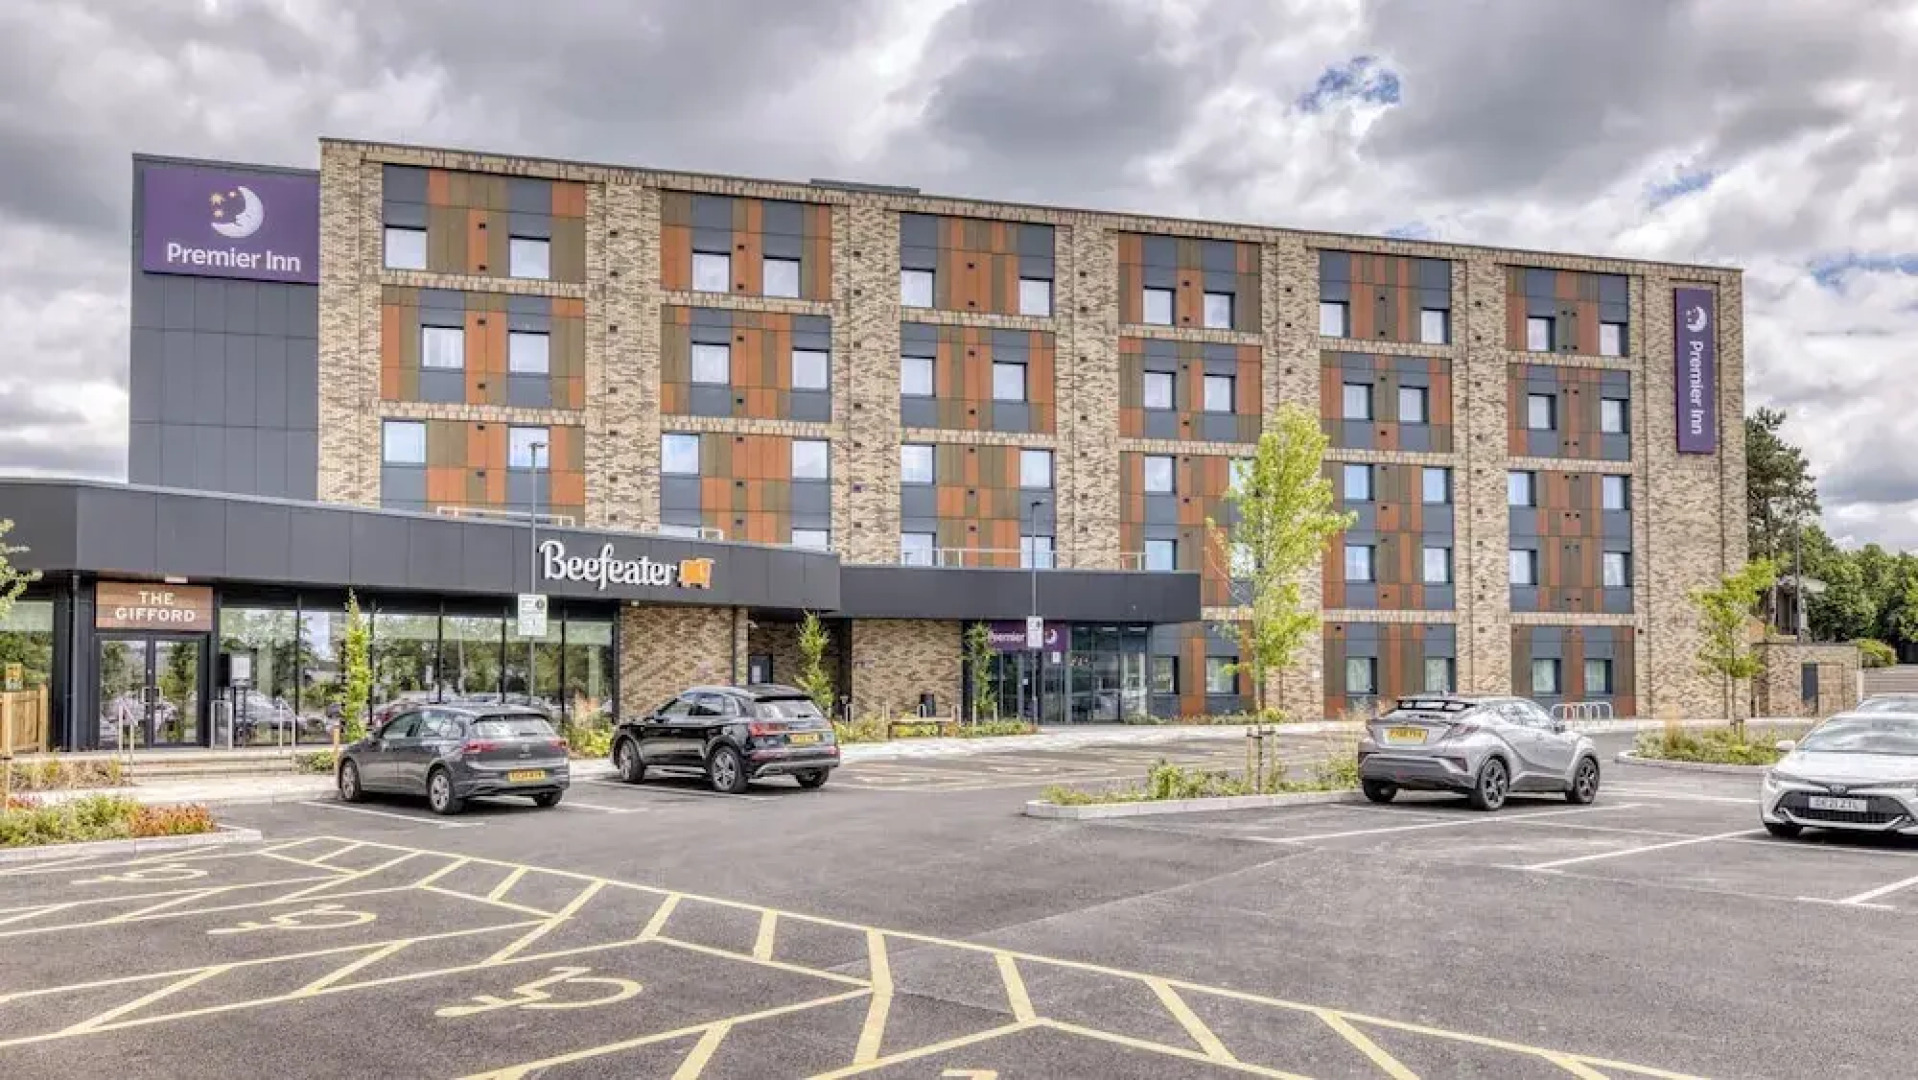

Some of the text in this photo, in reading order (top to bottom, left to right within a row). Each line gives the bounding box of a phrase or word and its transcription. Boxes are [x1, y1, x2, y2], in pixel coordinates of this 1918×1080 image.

[166, 242, 302, 273] Premier Inn
[1689, 340, 1704, 435] Premier Inn
[538, 540, 678, 591] Beefeater
[138, 590, 176, 606] THE
[115, 607, 196, 623] GIFFORD
